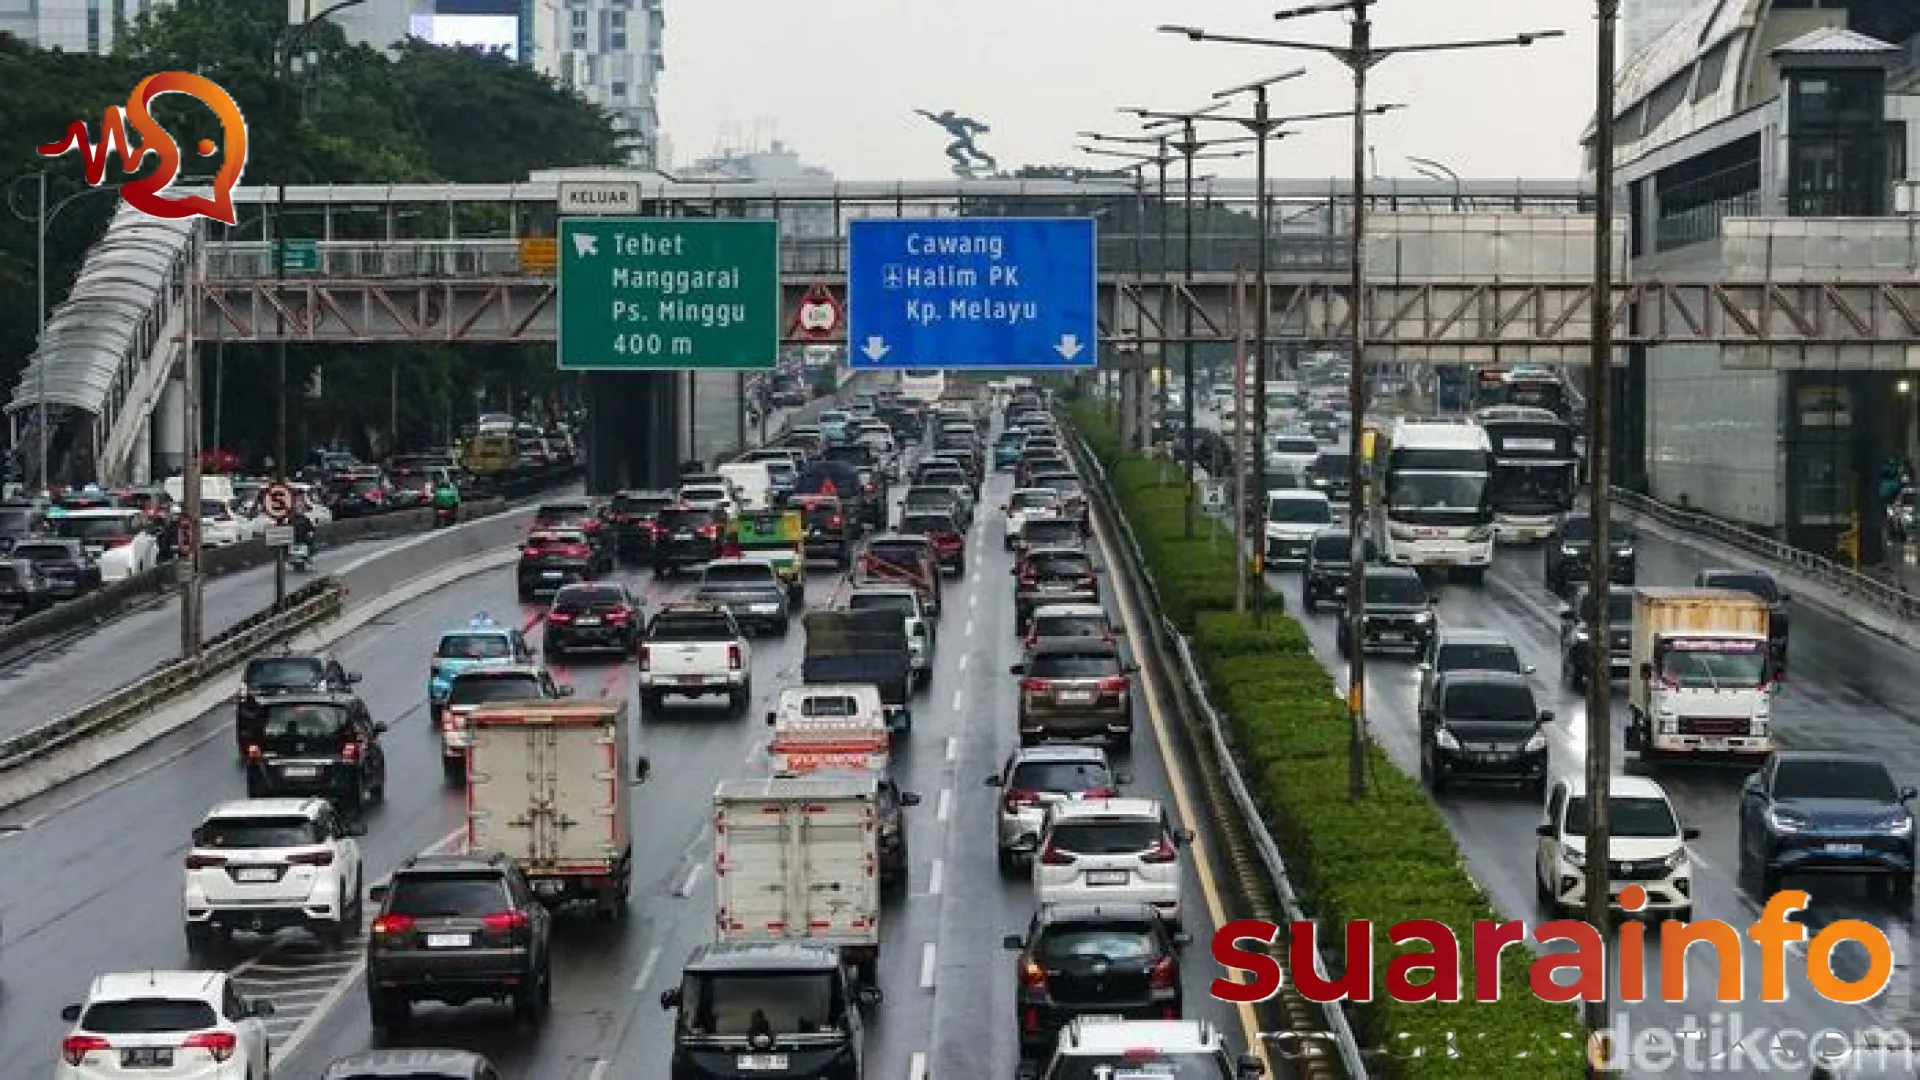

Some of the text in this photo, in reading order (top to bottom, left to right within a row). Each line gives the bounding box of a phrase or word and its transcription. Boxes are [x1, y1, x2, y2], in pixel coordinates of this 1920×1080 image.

[570, 190, 629, 204] KELUAR
[613, 233, 684, 255] Tebet
[907, 234, 1003, 260] Cawang
[612, 267, 739, 294] Manggarai
[907, 265, 1019, 286] Halim PK
[613, 301, 745, 327] Ps. Minggu
[907, 298, 1038, 326] Kp. Melayu
[613, 333, 692, 354] 400 m
